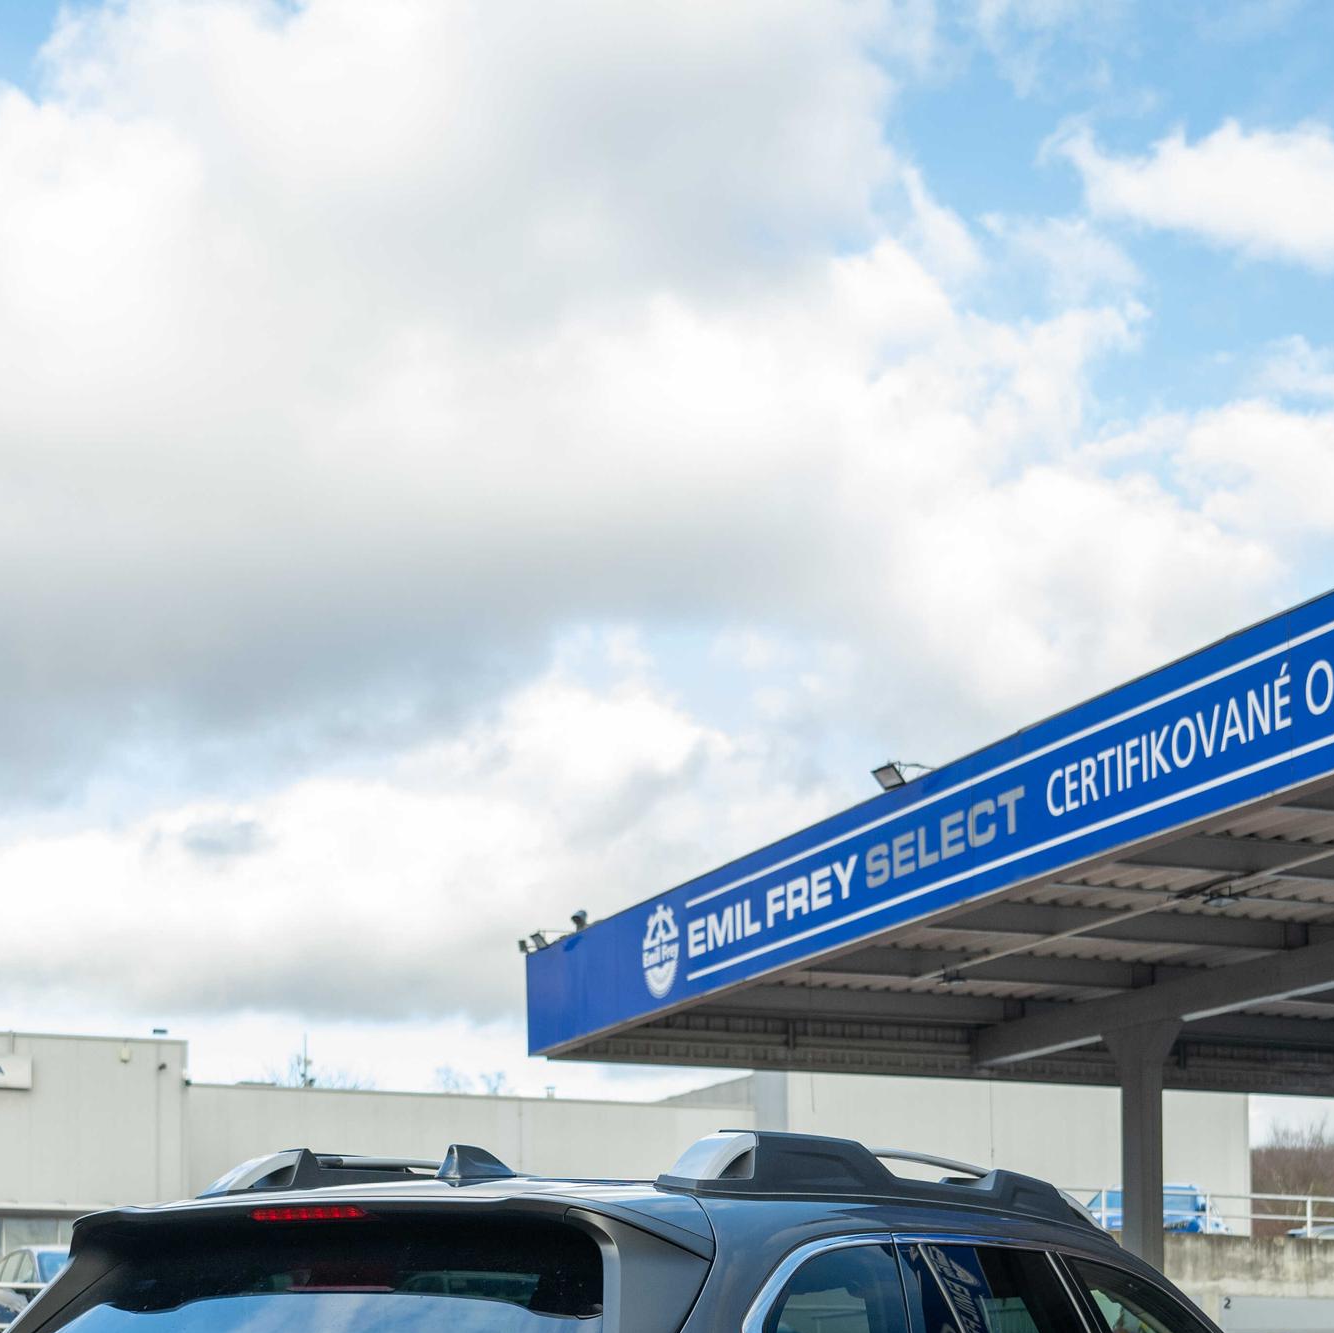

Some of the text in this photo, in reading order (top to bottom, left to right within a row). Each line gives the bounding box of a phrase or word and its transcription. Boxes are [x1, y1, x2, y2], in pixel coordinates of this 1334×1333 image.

[687, 898, 762, 959] EMIL
[767, 854, 858, 929] FREY
[865, 785, 1025, 889] SELECT
[1045, 662, 1293, 818] CERTIFIKOVANÉ
[1223, 1297, 1232, 1309] 2
